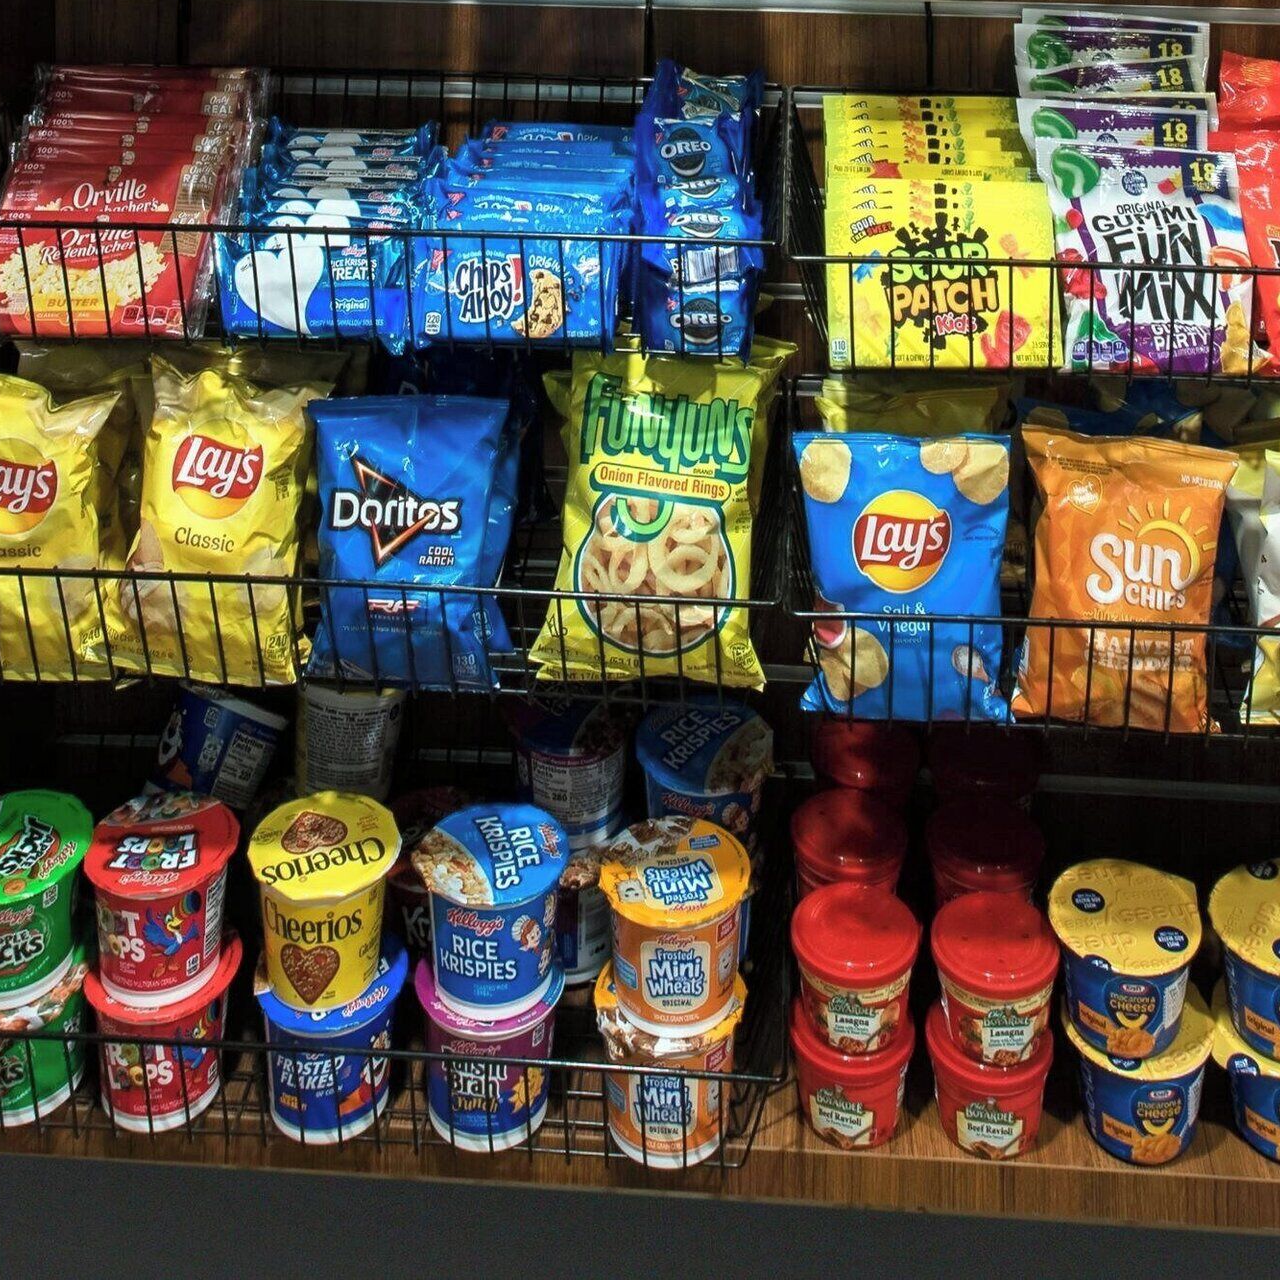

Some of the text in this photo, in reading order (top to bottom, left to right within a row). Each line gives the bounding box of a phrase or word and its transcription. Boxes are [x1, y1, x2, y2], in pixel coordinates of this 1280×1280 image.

[1158, 42, 1183, 58] 18
[1157, 67, 1183, 87] 18
[1161, 122, 1189, 142] 18
[660, 140, 712, 160] OREO
[183, 175, 214, 186] REAL
[1189, 161, 1217, 183] 18
[73, 178, 148, 211] Orville
[670, 213, 731, 226] OREO
[851, 216, 877, 234] SOUR
[1091, 206, 1199, 233] GUMMI
[888, 242, 989, 285] SOUR
[887, 276, 1000, 323] PATCH
[669, 313, 732, 329] OREO
[934, 312, 979, 337] Kids
[176, 435, 260, 499] Lay's
[599, 465, 726, 499] Onion Flavored Rings
[331, 491, 460, 532] Doritos
[174, 526, 235, 554] Classic
[427, 545, 454, 557] COOL
[860, 515, 947, 571] Lay's
[418, 555, 455, 567] RANCH
[1084, 532, 1192, 606] Sun
[1123, 583, 1187, 611] CHIPS
[269, 633, 288, 649] 240
[474, 815, 521, 891] KRISPIES
[507, 826, 541, 867] RICE
[260, 836, 386, 887] Cheerios
[264, 897, 364, 947] Cheerios
[446, 907, 505, 937] Kellogg's
[451, 932, 499, 961] RICE
[655, 948, 695, 962] Frosted
[439, 949, 518, 982] KRISPIES
[649, 958, 705, 982] Mini
[647, 975, 705, 998] Wheats
[834, 1015, 870, 1027] Lasagna
[989, 1028, 1025, 1038] Lasagna
[1247, 1016, 1276, 1036] original
[833, 1112, 862, 1128] Ravioli
[967, 1123, 1014, 1137] Beef Ravioli
